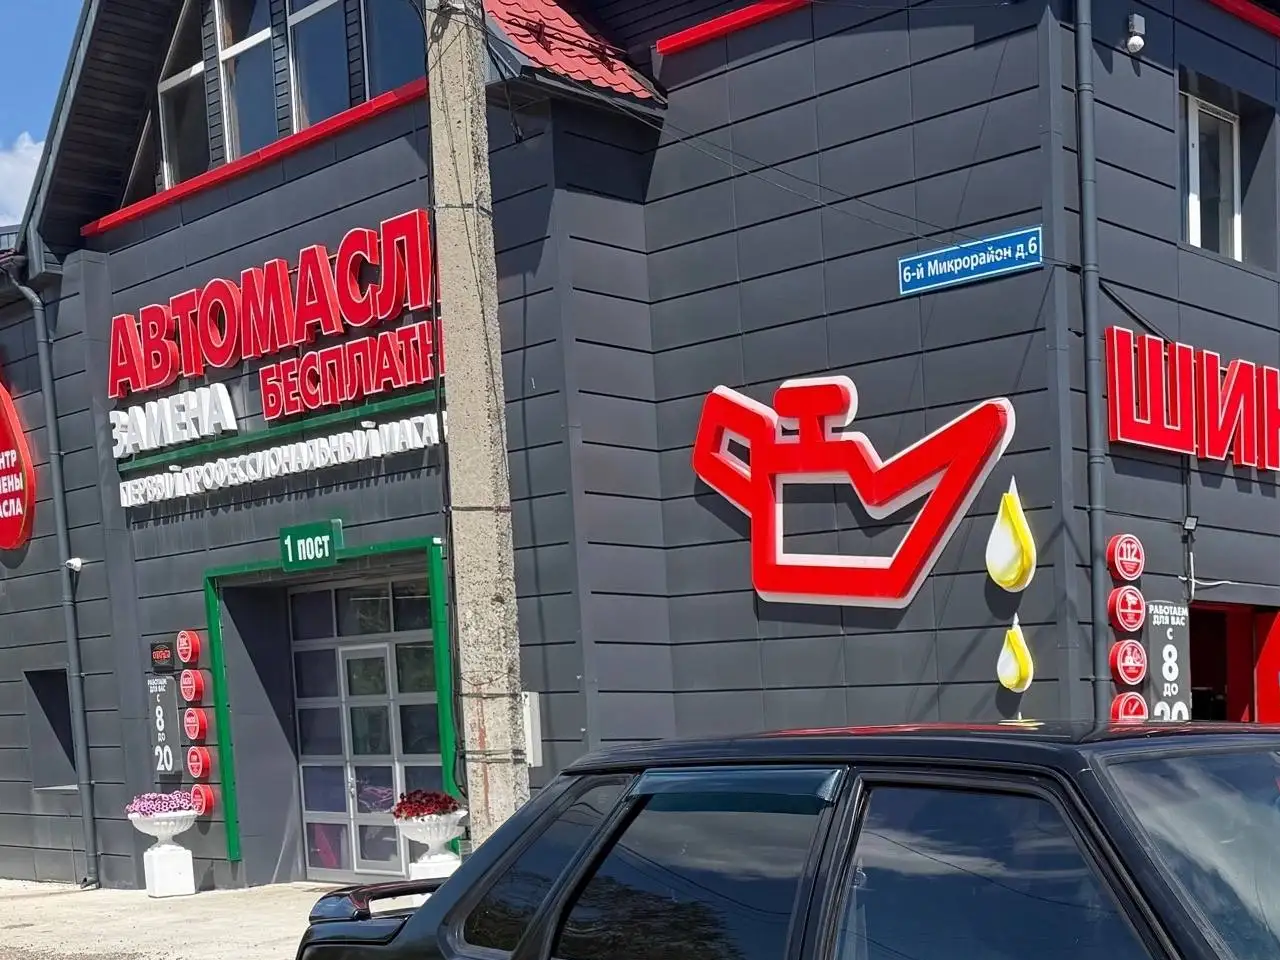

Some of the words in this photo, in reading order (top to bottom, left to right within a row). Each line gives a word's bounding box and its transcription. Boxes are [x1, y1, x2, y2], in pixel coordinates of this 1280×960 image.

[903, 263, 925, 283] 6-й
[927, 245, 1012, 278] Микрорайон
[1015, 236, 1038, 261] д.6
[108, 207, 442, 399] АВТОМАСЛ
[260, 317, 446, 421] БЕСПЛАТН
[109, 382, 237, 459] ЗАМЕНА
[0, 449, 17, 470] НТР
[120, 464, 186, 507] ПЕРВЫЙ
[182, 420, 382, 495] ПРОФЕССИОНАЛЬНЫЙ
[379, 411, 448, 453] МАГА
[0, 472, 23, 495] ЕНЫ
[284, 534, 293, 563] 1
[1121, 542, 1138, 560] 112
[1148, 604, 1189, 617] РАБОТАЕМ
[1152, 616, 1170, 626] ДЛЯ
[1170, 616, 1186, 626] ВАС
[1162, 644, 1179, 682] 8
[1163, 683, 1179, 697] ДО
[155, 705, 165, 732] 8
[154, 744, 173, 772] 20
